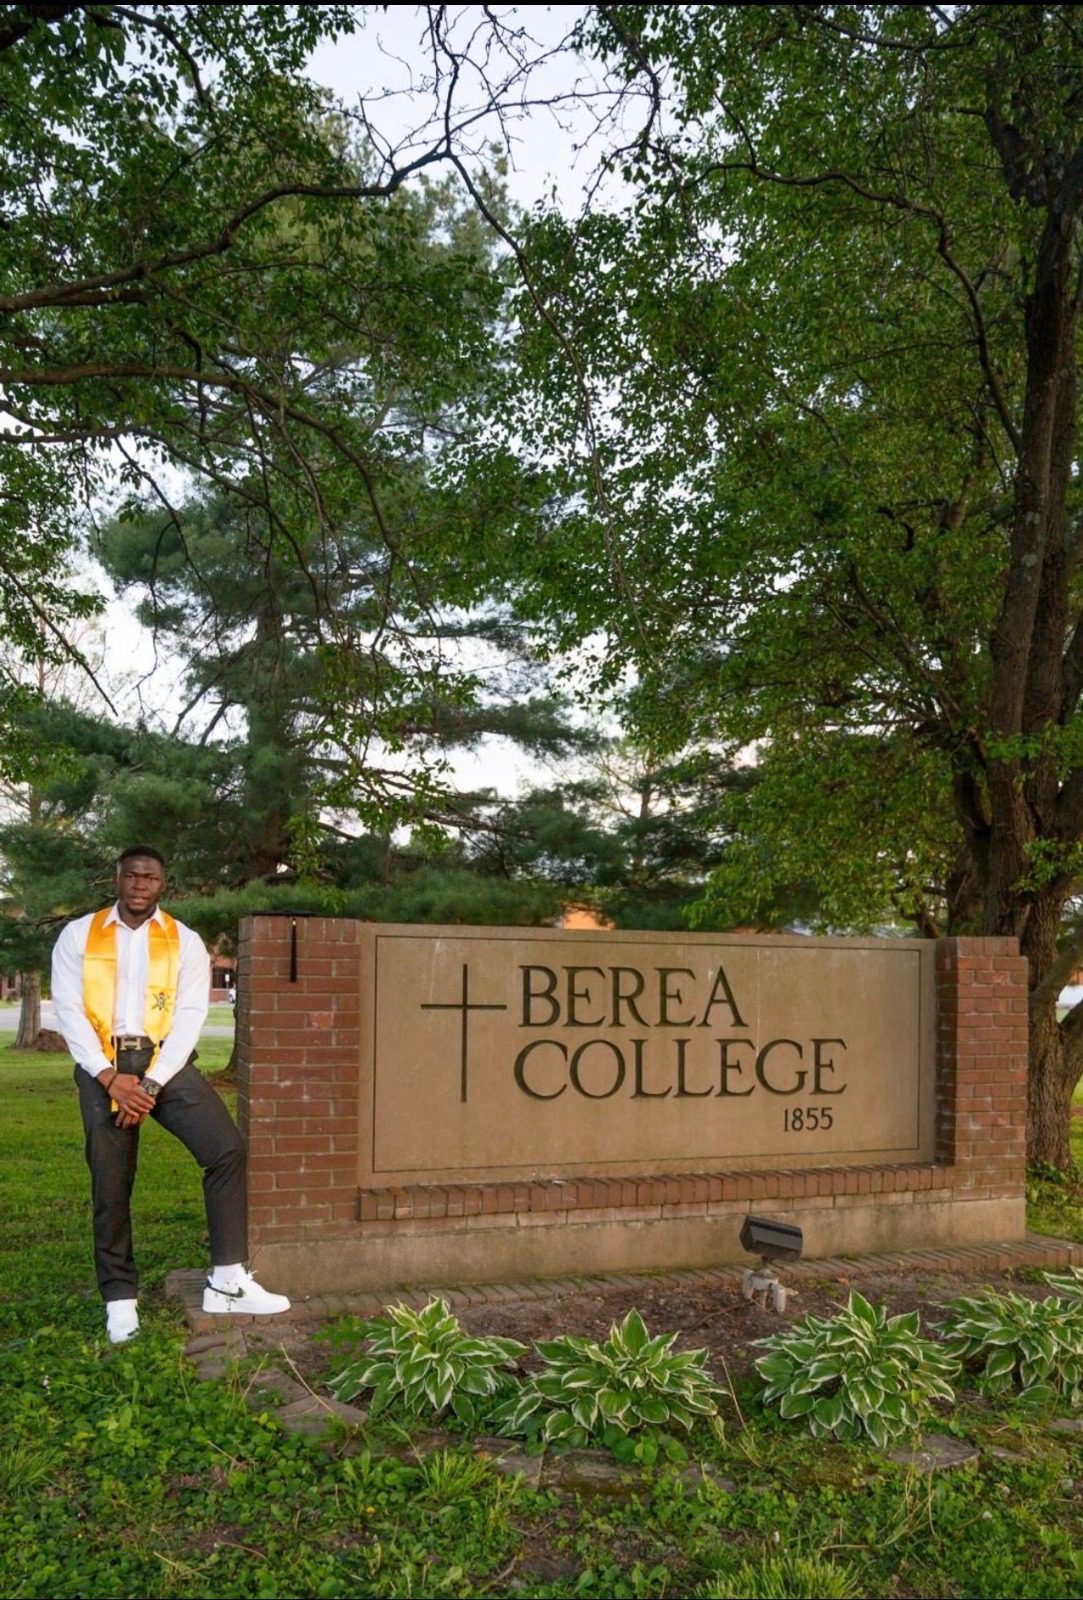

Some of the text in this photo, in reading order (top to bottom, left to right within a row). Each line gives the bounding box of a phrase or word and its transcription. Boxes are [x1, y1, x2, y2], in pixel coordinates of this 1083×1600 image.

[517, 964, 749, 1028] BEREA
[513, 1038, 848, 1101] COLLEGE
[783, 1107, 833, 1132] 1855
